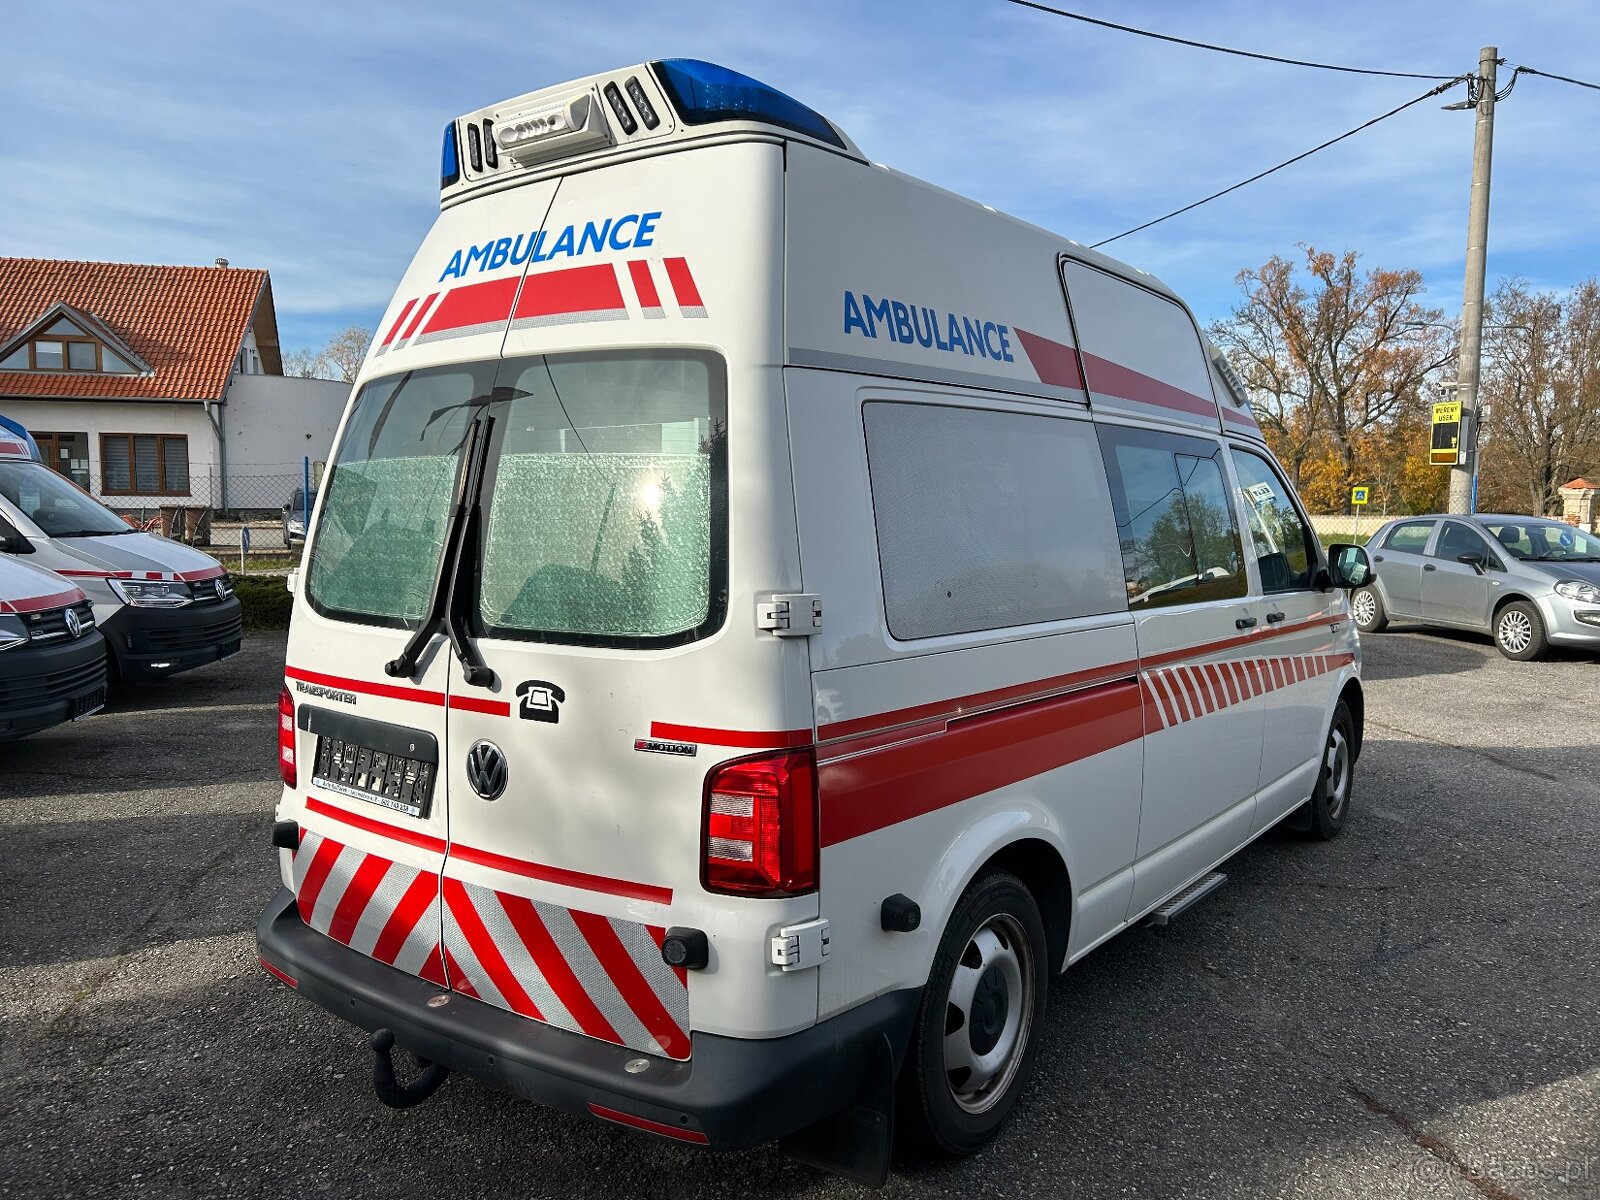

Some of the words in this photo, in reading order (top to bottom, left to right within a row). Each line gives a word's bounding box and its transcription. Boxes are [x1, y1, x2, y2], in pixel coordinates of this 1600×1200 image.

[438, 211, 662, 283] AMBULANCE
[844, 290, 1014, 363] AMBULANCE
[296, 681, 357, 705] TRANSPORTER
[467, 739, 508, 800] VW
